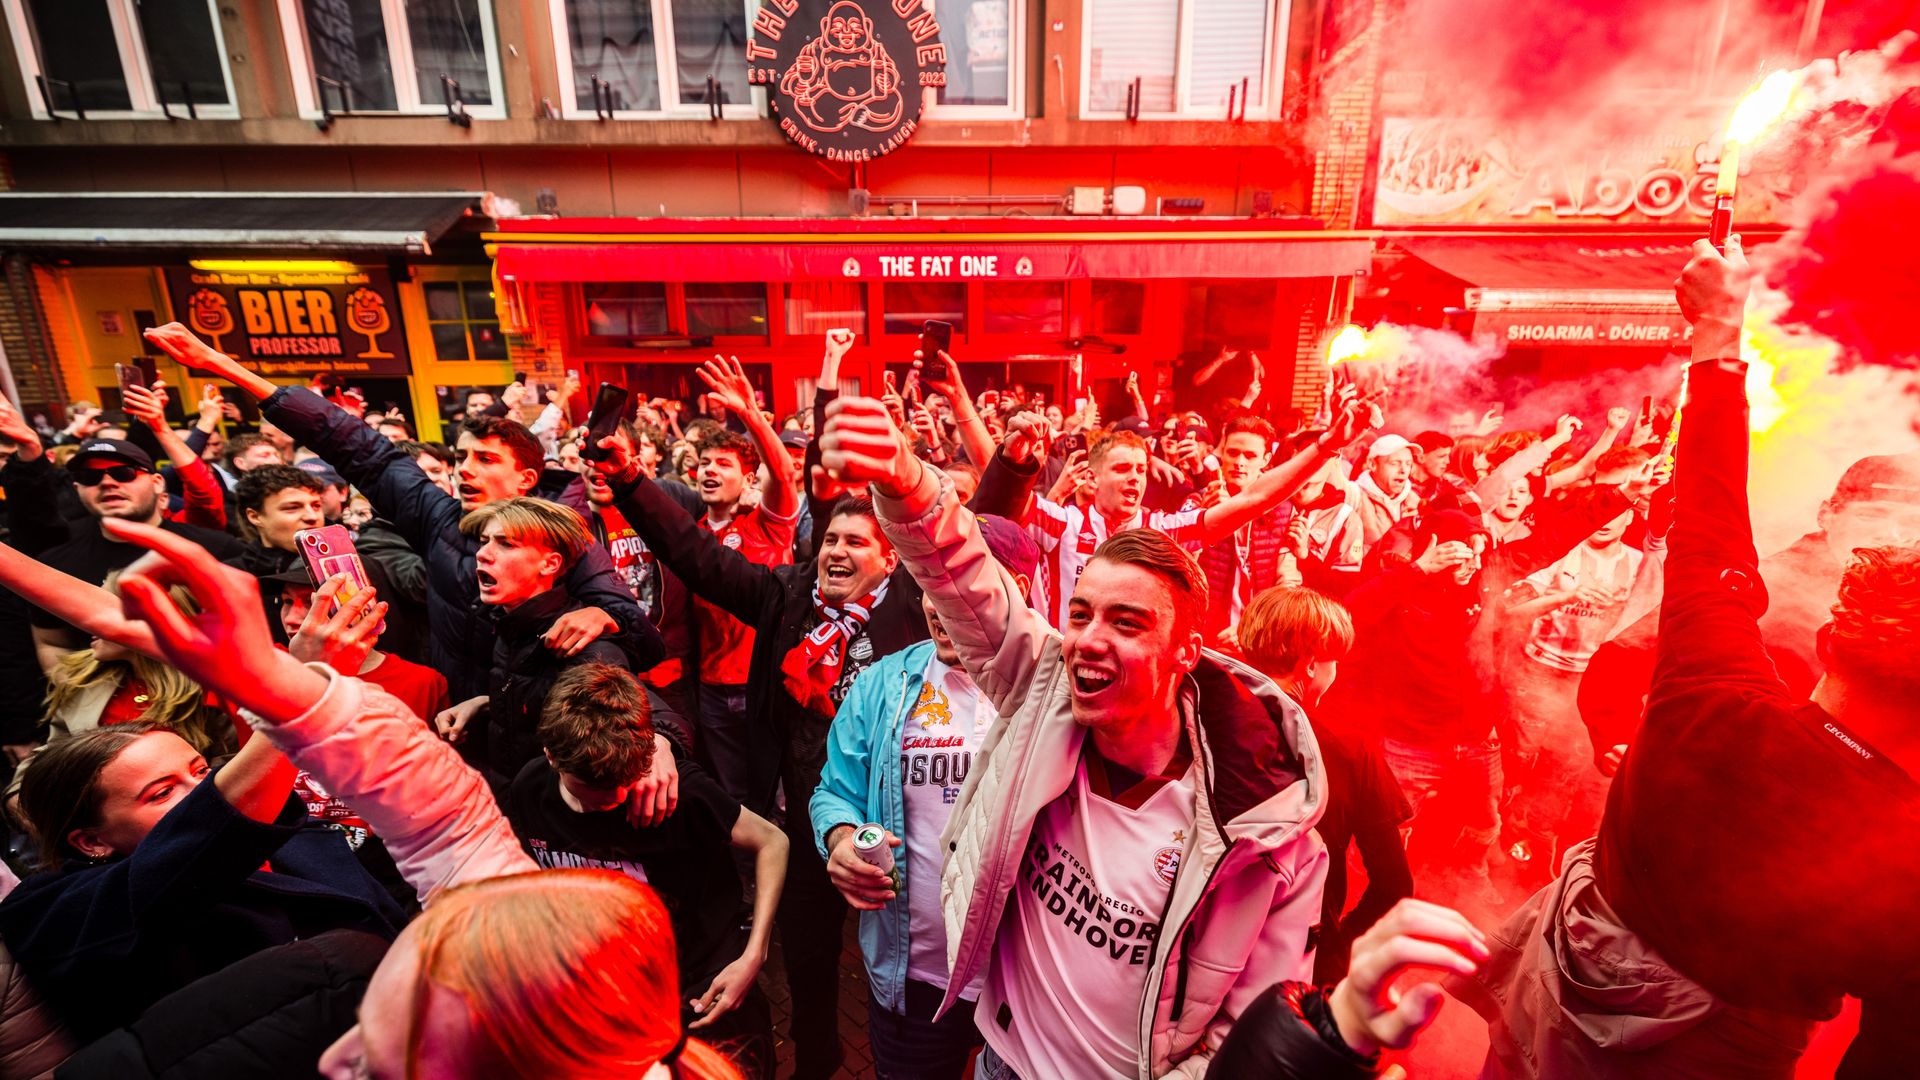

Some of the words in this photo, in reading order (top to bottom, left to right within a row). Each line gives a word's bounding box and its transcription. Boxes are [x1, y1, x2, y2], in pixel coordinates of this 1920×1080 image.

[747, 69, 776, 83] EST
[918, 72, 946, 86] 2023
[780, 117, 817, 154] DRINK
[826, 147, 870, 163] DANCE
[879, 118, 918, 155] LAUGH
[879, 256, 915, 276] THE
[921, 256, 953, 276] FAT
[960, 256, 998, 276] ONE
[238, 290, 337, 334] BIER
[1508, 325, 1595, 340] SHOARMA
[1609, 323, 1671, 340] DÖNER
[250, 337, 342, 355] PROFESSOR
[902, 735, 965, 751] Canada
[1028, 834, 1159, 942] RAINPOR
[1024, 863, 1149, 966] INDHOVE
